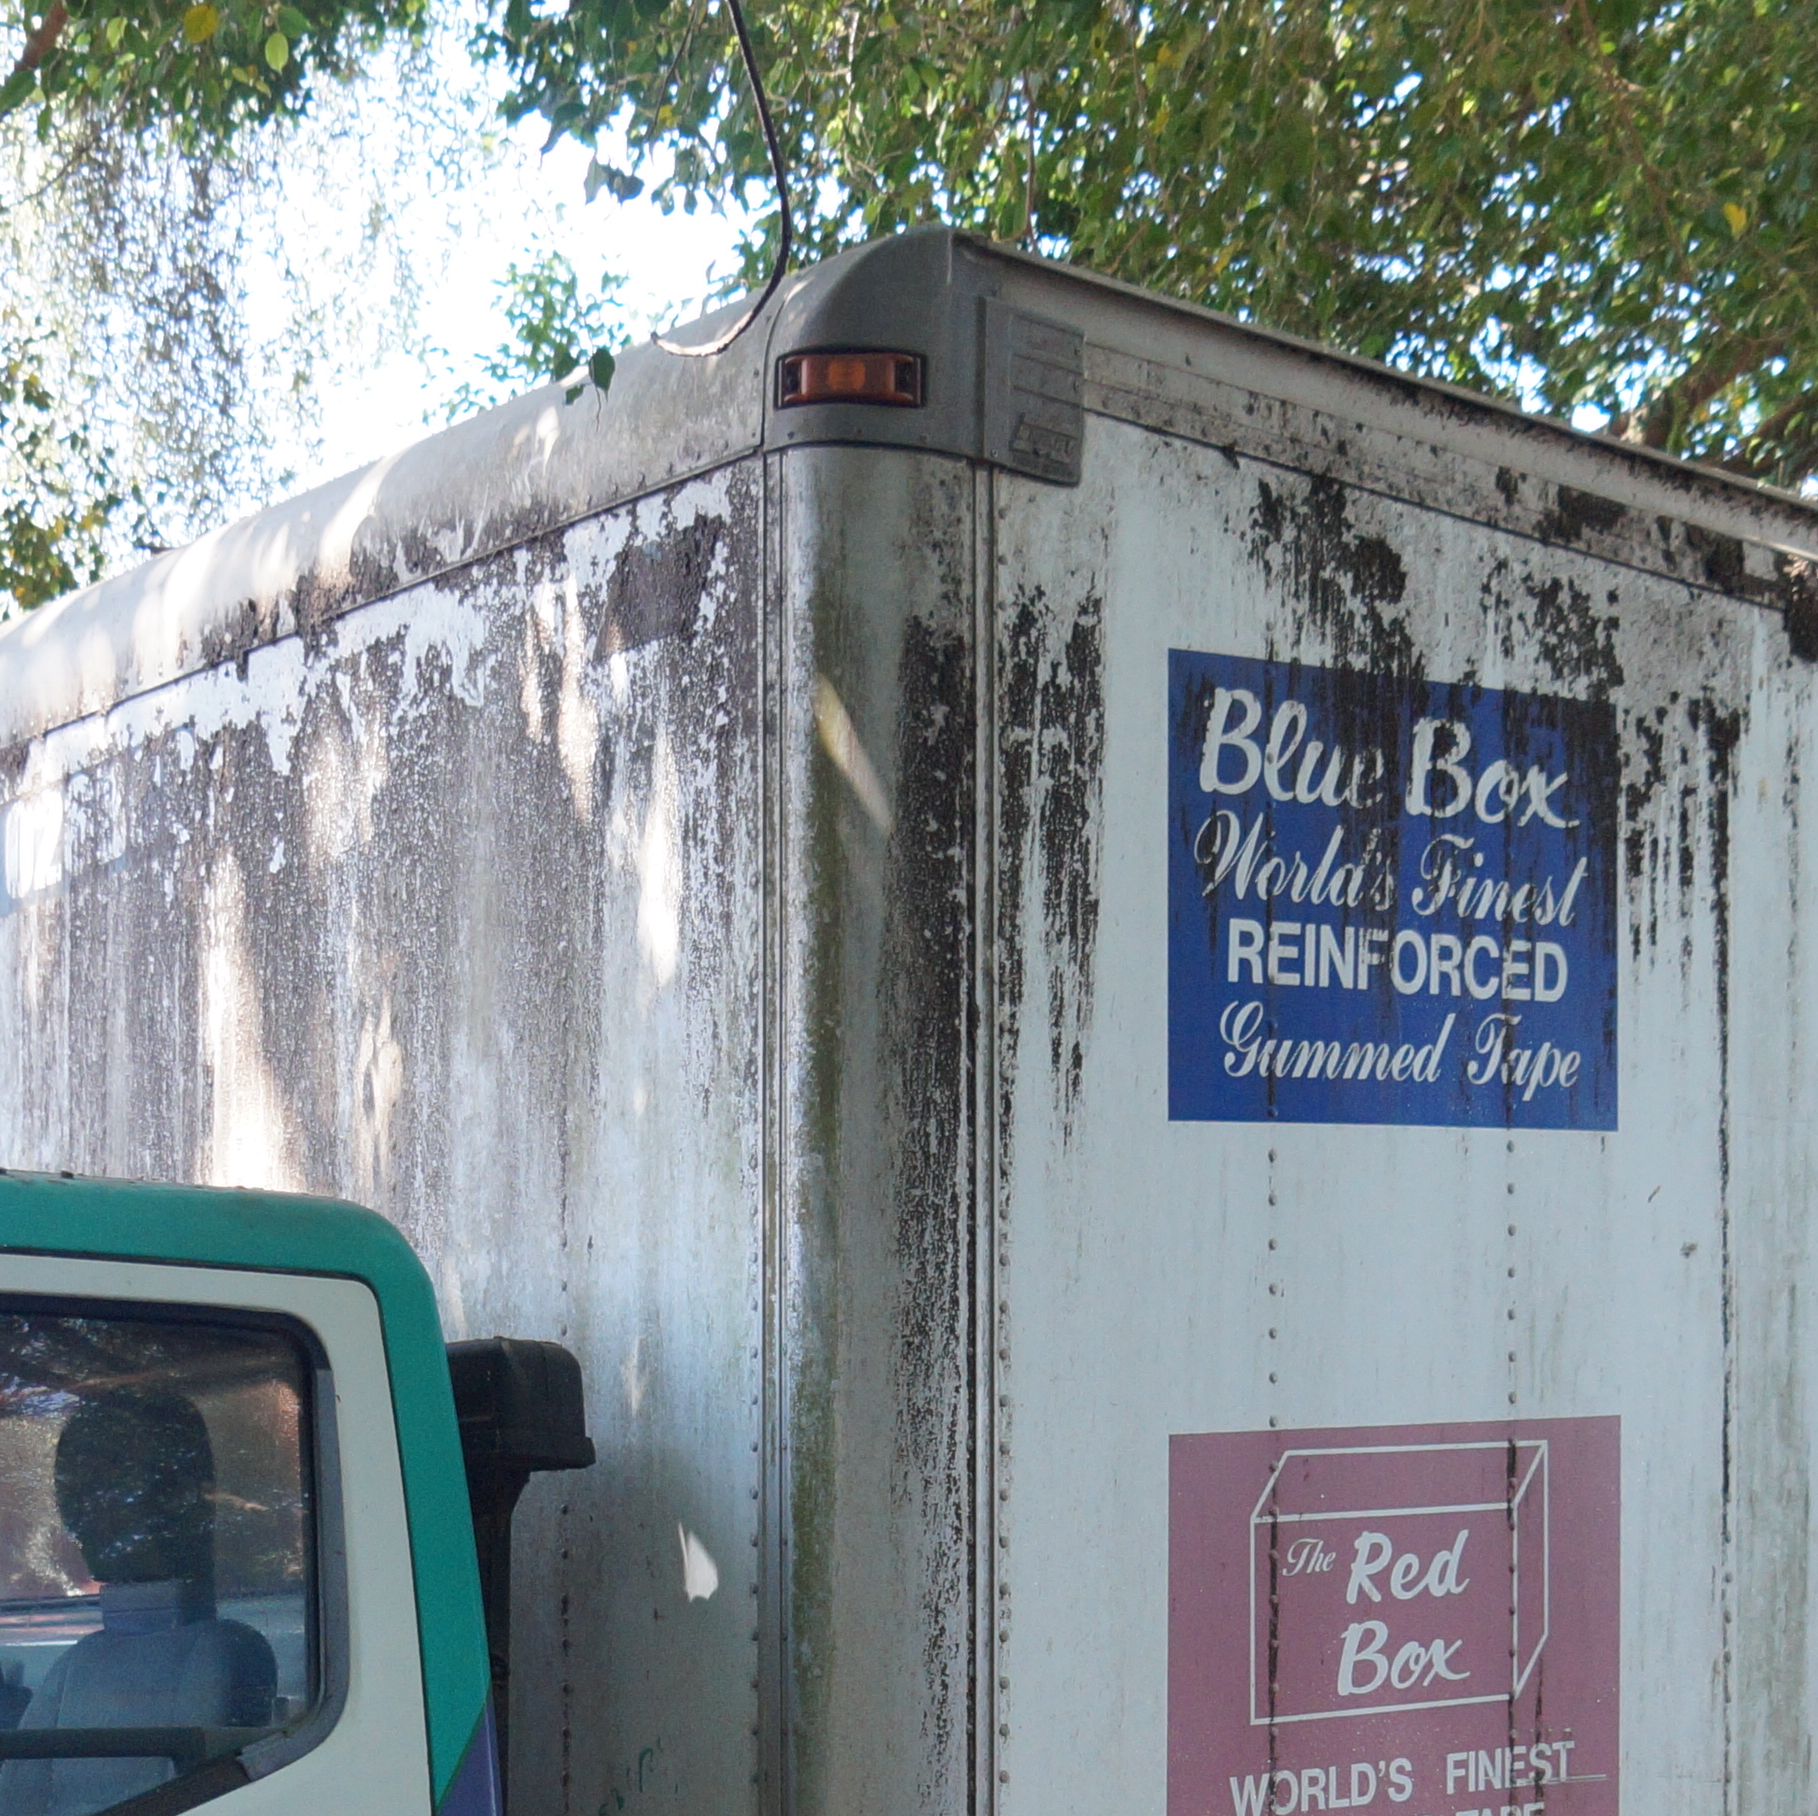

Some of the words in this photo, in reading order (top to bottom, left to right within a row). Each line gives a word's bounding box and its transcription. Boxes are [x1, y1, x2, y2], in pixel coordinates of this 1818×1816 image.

[1199, 687, 1383, 808] Blue
[1404, 717, 1579, 828] Box
[1194, 811, 1394, 910] World's
[1411, 833, 1587, 927] Finest
[1228, 919, 1568, 1002] REINFORCED
[1220, 1001, 1456, 1083] Gummed
[1468, 1012, 1580, 1101] Tape
[1282, 1538, 1337, 1576] The
[1346, 1529, 1470, 1604] Red
[1337, 1620, 1470, 1696] Box
[1446, 1741, 1575, 1794] FINEST
